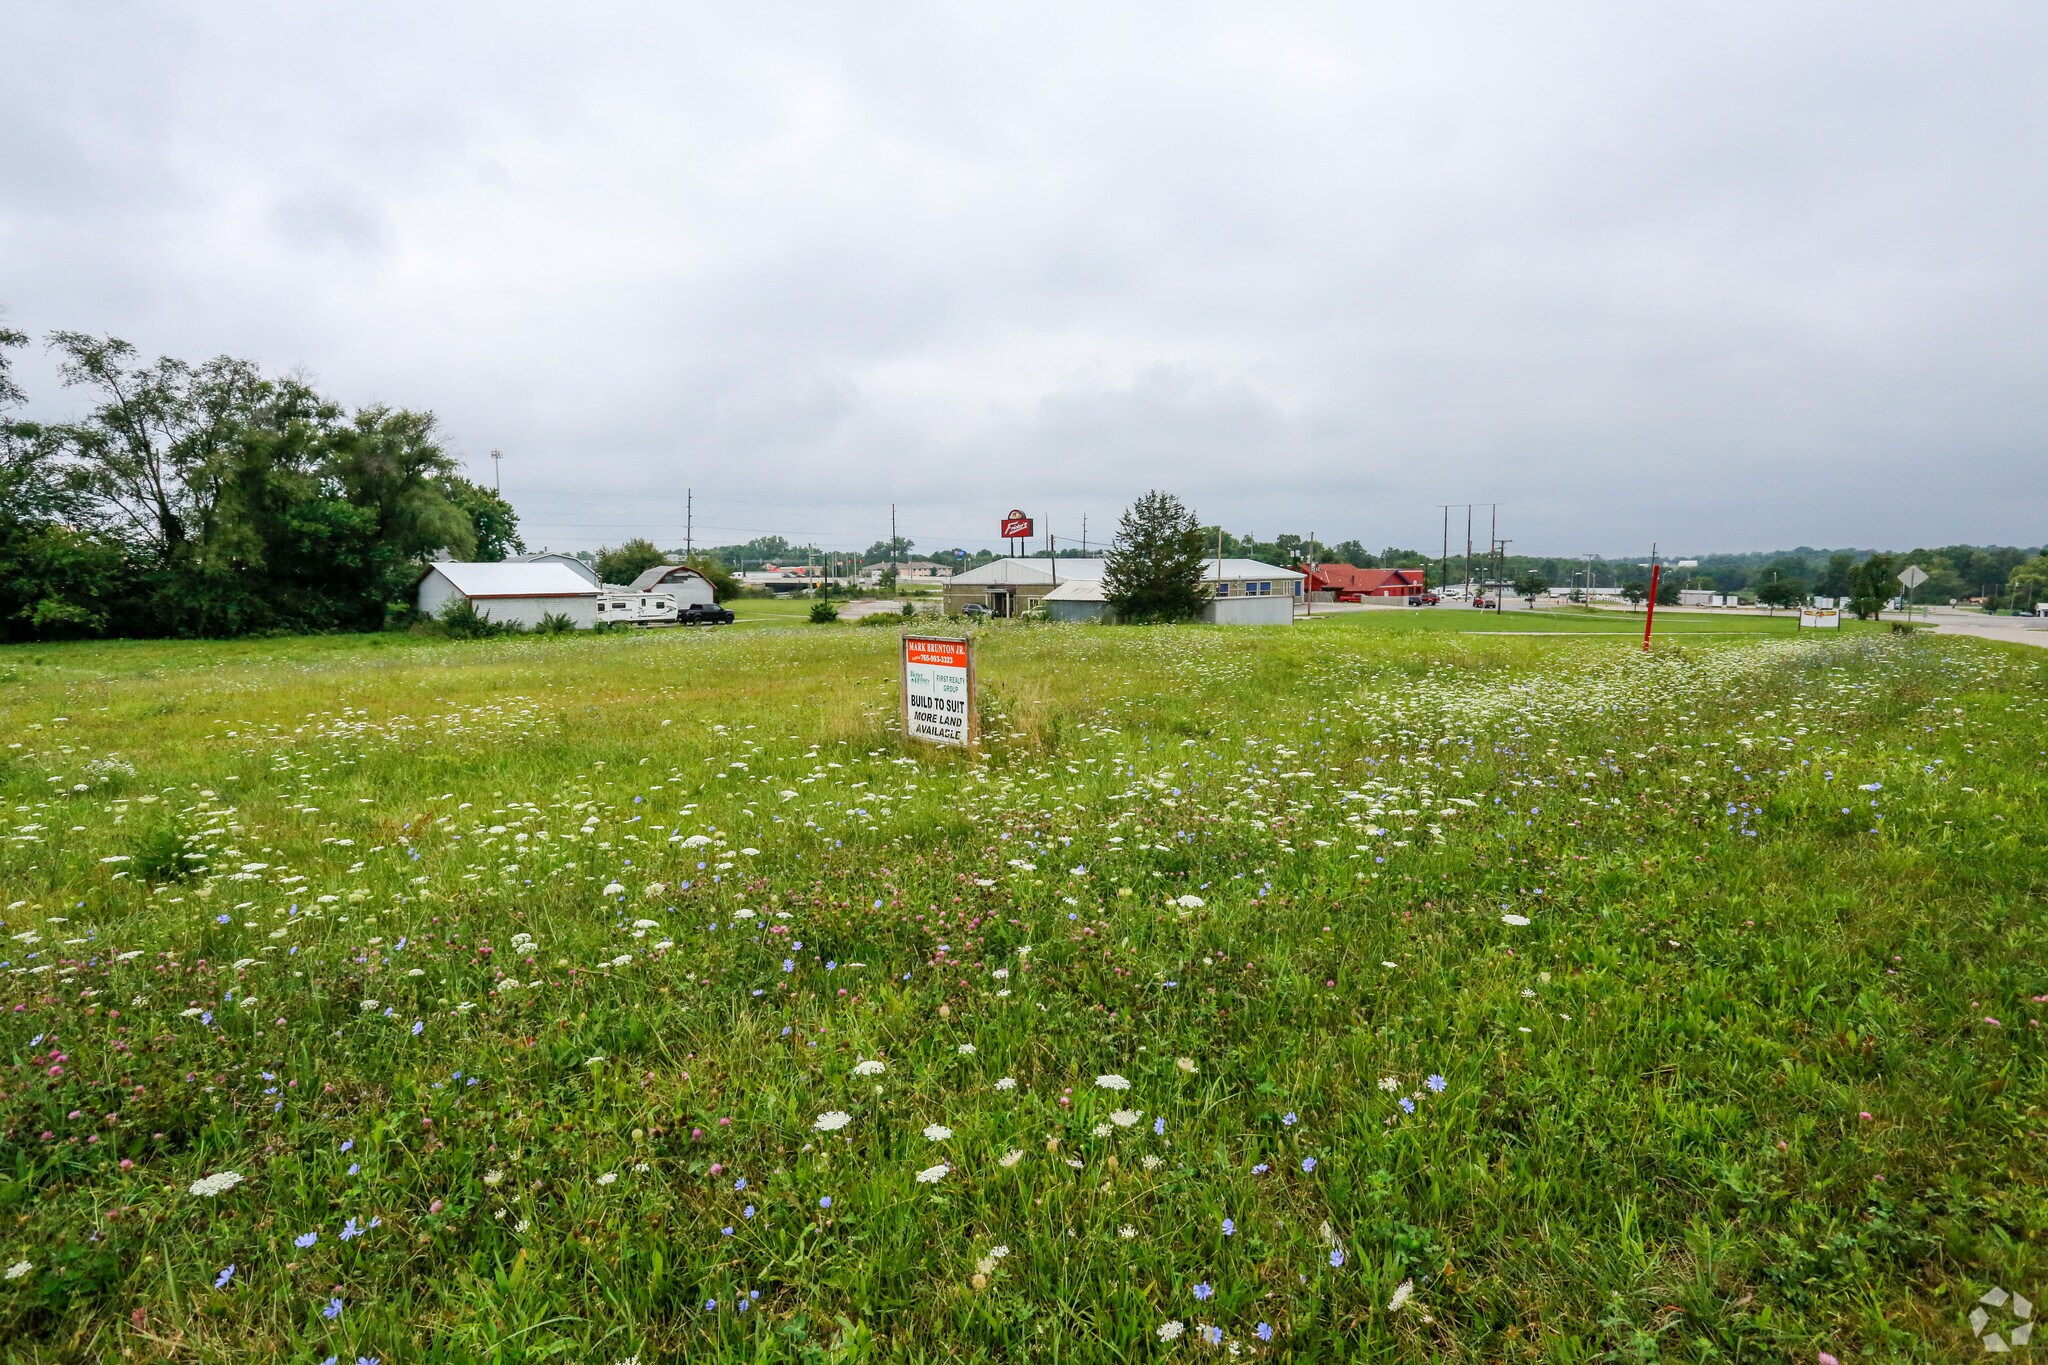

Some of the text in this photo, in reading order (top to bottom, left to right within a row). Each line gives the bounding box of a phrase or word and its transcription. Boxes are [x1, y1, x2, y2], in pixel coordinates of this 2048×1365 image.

[909, 642, 926, 651] MARK
[927, 643, 955, 654] BRUNTON
[949, 676, 965, 684] REALTY
[911, 694, 965, 713] BUILD TO SUIT
[914, 711, 962, 727] MORE LAND
[916, 724, 961, 740] AVAILABLE
